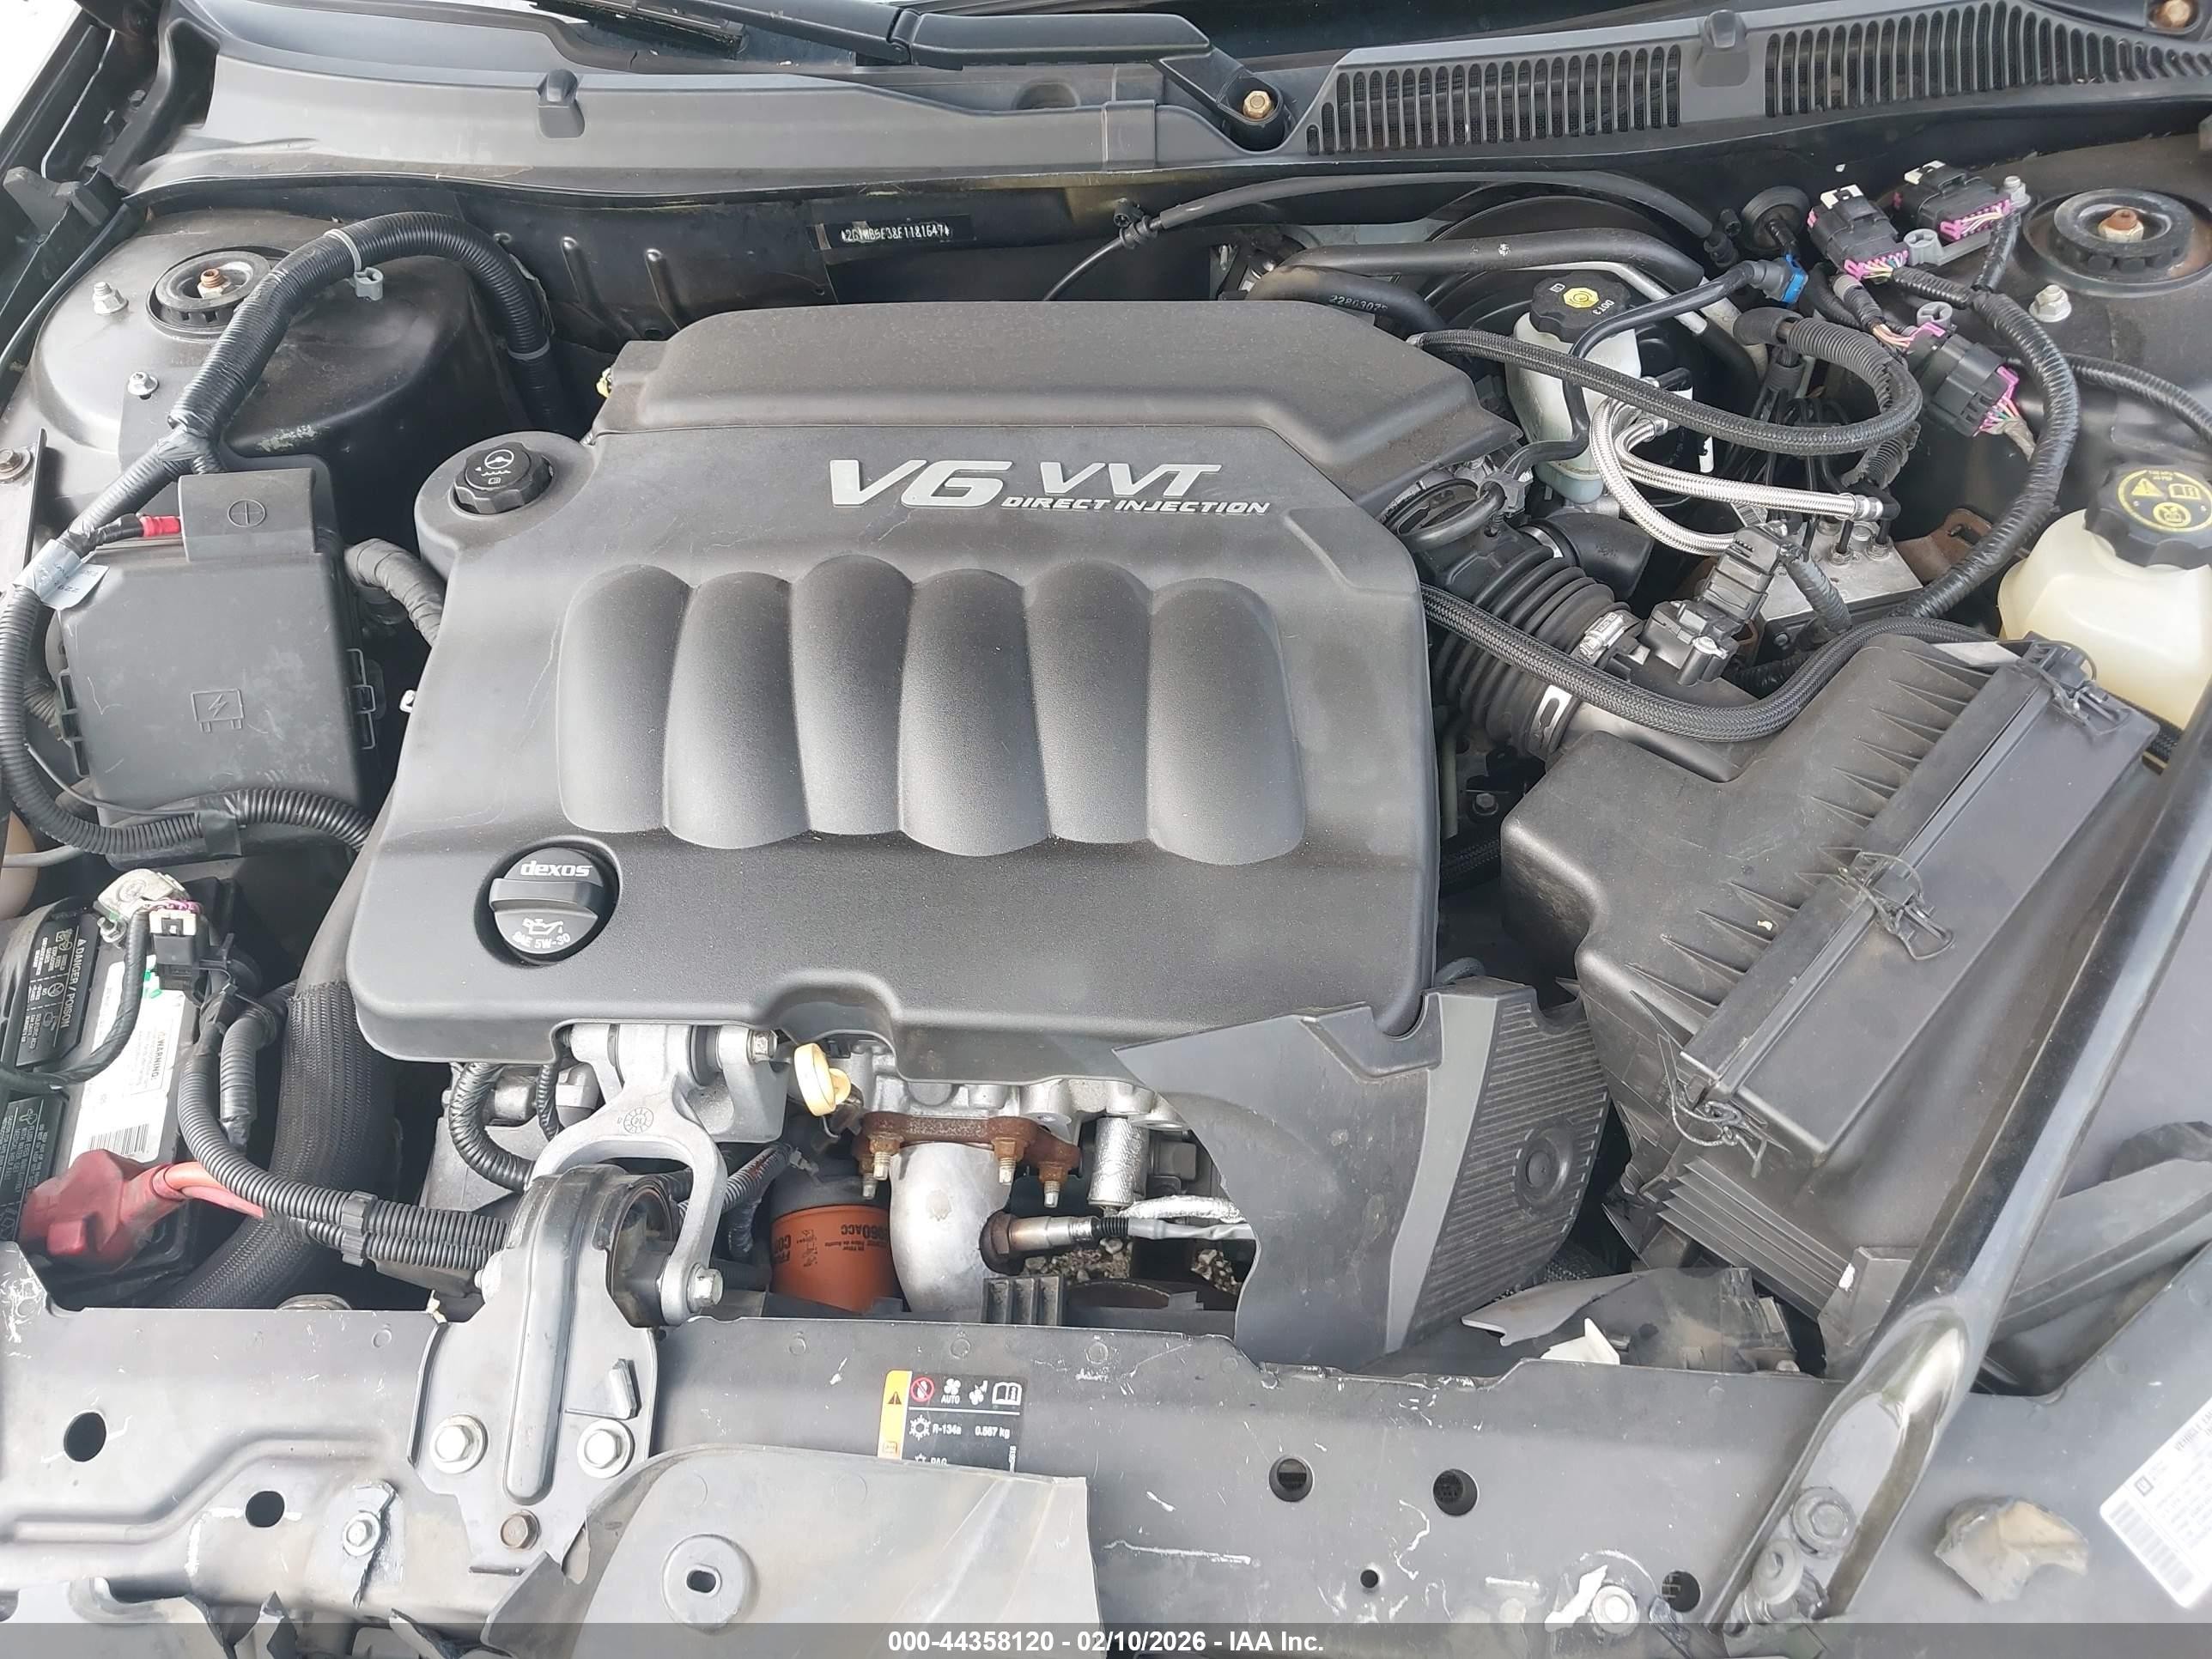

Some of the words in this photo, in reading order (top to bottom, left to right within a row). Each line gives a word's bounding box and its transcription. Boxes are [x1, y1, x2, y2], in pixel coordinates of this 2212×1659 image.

[829, 459, 1015, 508] V6
[1039, 461, 1224, 498] VVT
[1000, 495, 1111, 513] DIRECT
[1114, 498, 1271, 515] INJECTION
[520, 860, 592, 877] dexos
[534, 933, 571, 949] 5W-30
[70, 946, 84, 984] DANGER
[60, 993, 76, 1028] POISON
[940, 1394, 960, 1405] AUTO
[933, 1423, 962, 1436] R-134a
[999, 1426, 1011, 1439] kg
